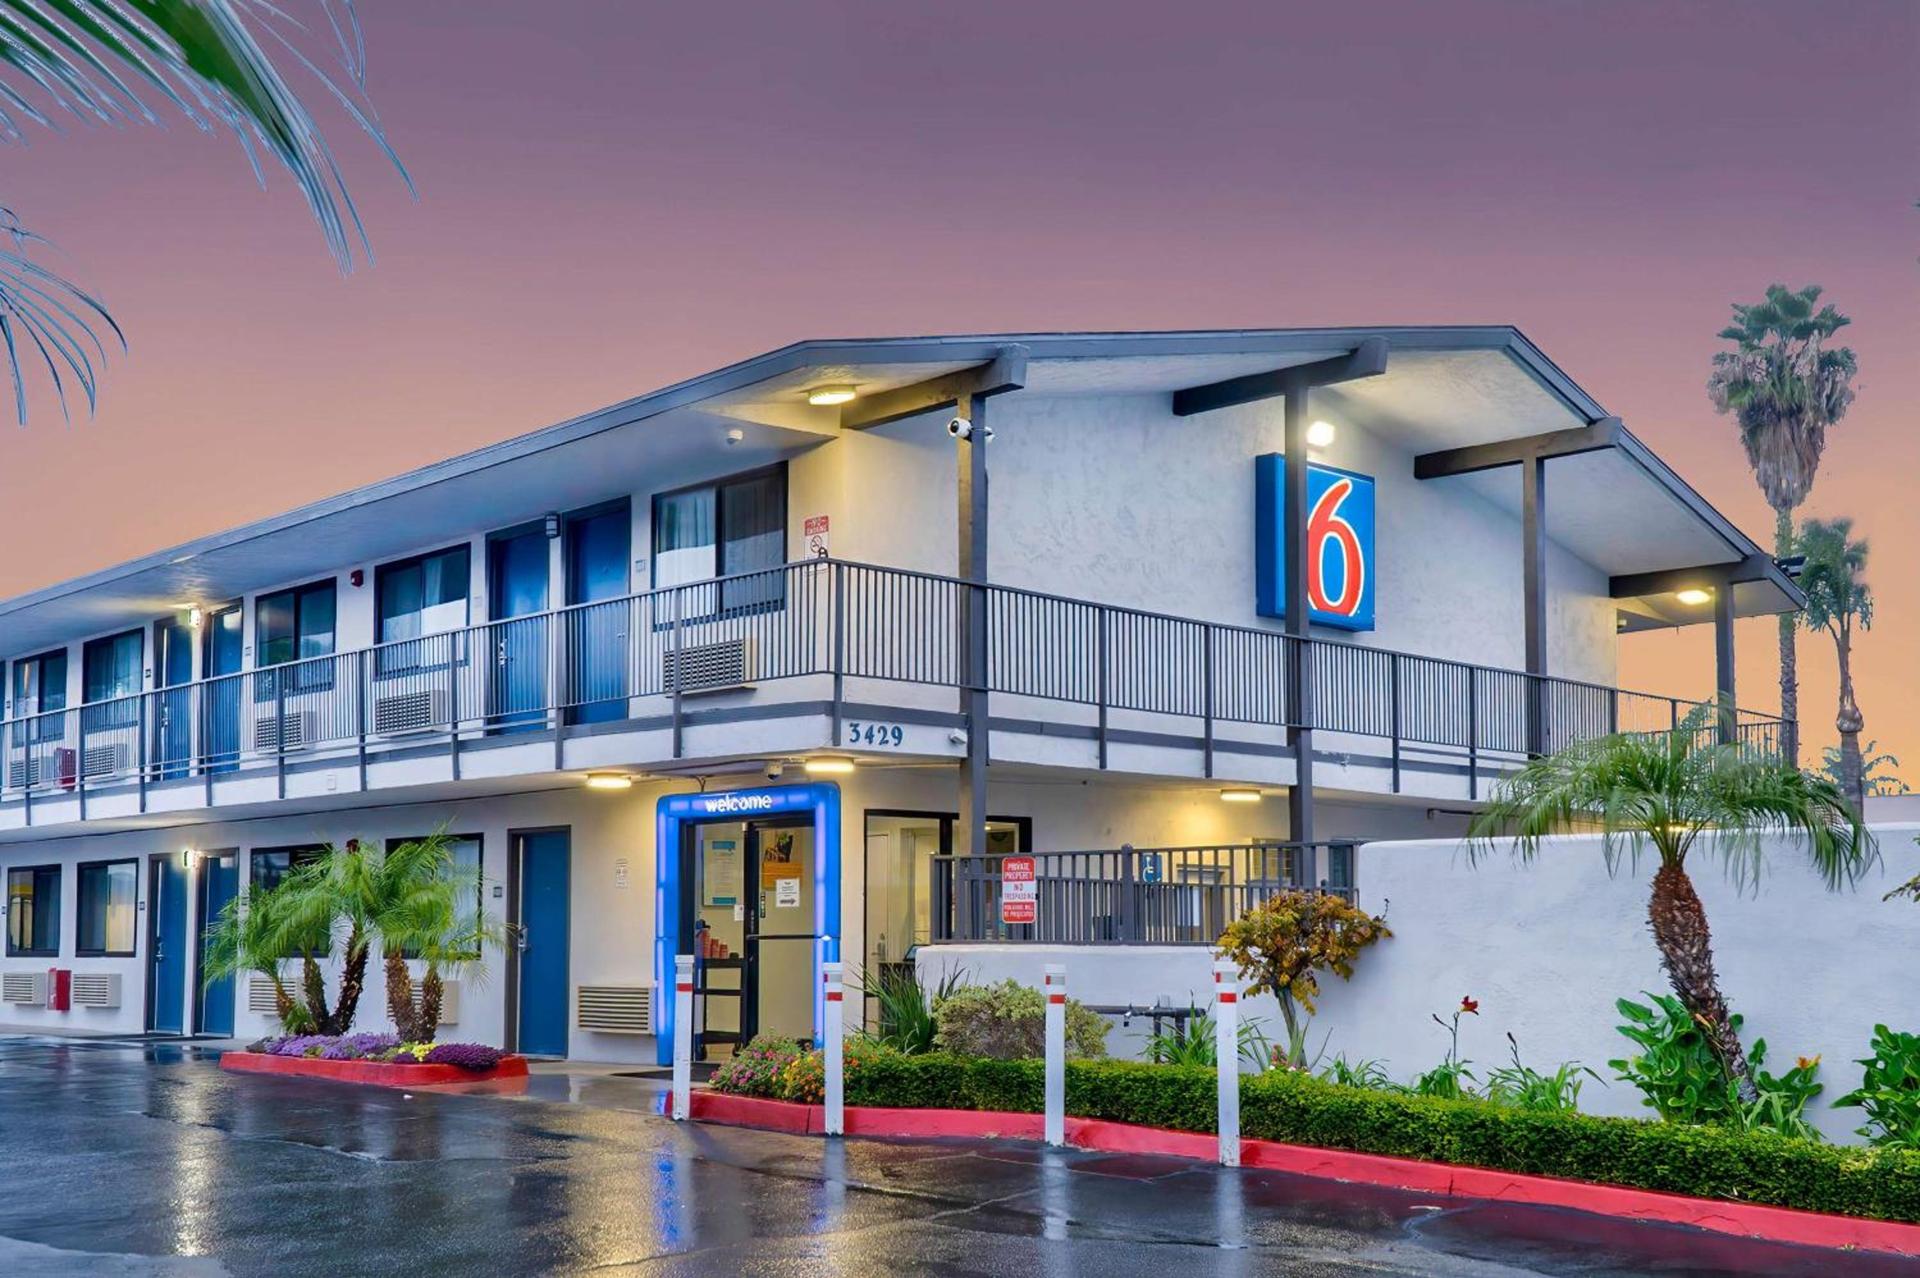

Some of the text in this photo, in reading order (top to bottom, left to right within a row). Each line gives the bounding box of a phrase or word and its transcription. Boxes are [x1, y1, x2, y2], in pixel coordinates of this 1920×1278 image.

[1307, 478, 1365, 617] 6
[849, 722, 903, 747] 3429
[704, 794, 772, 812] welcome
